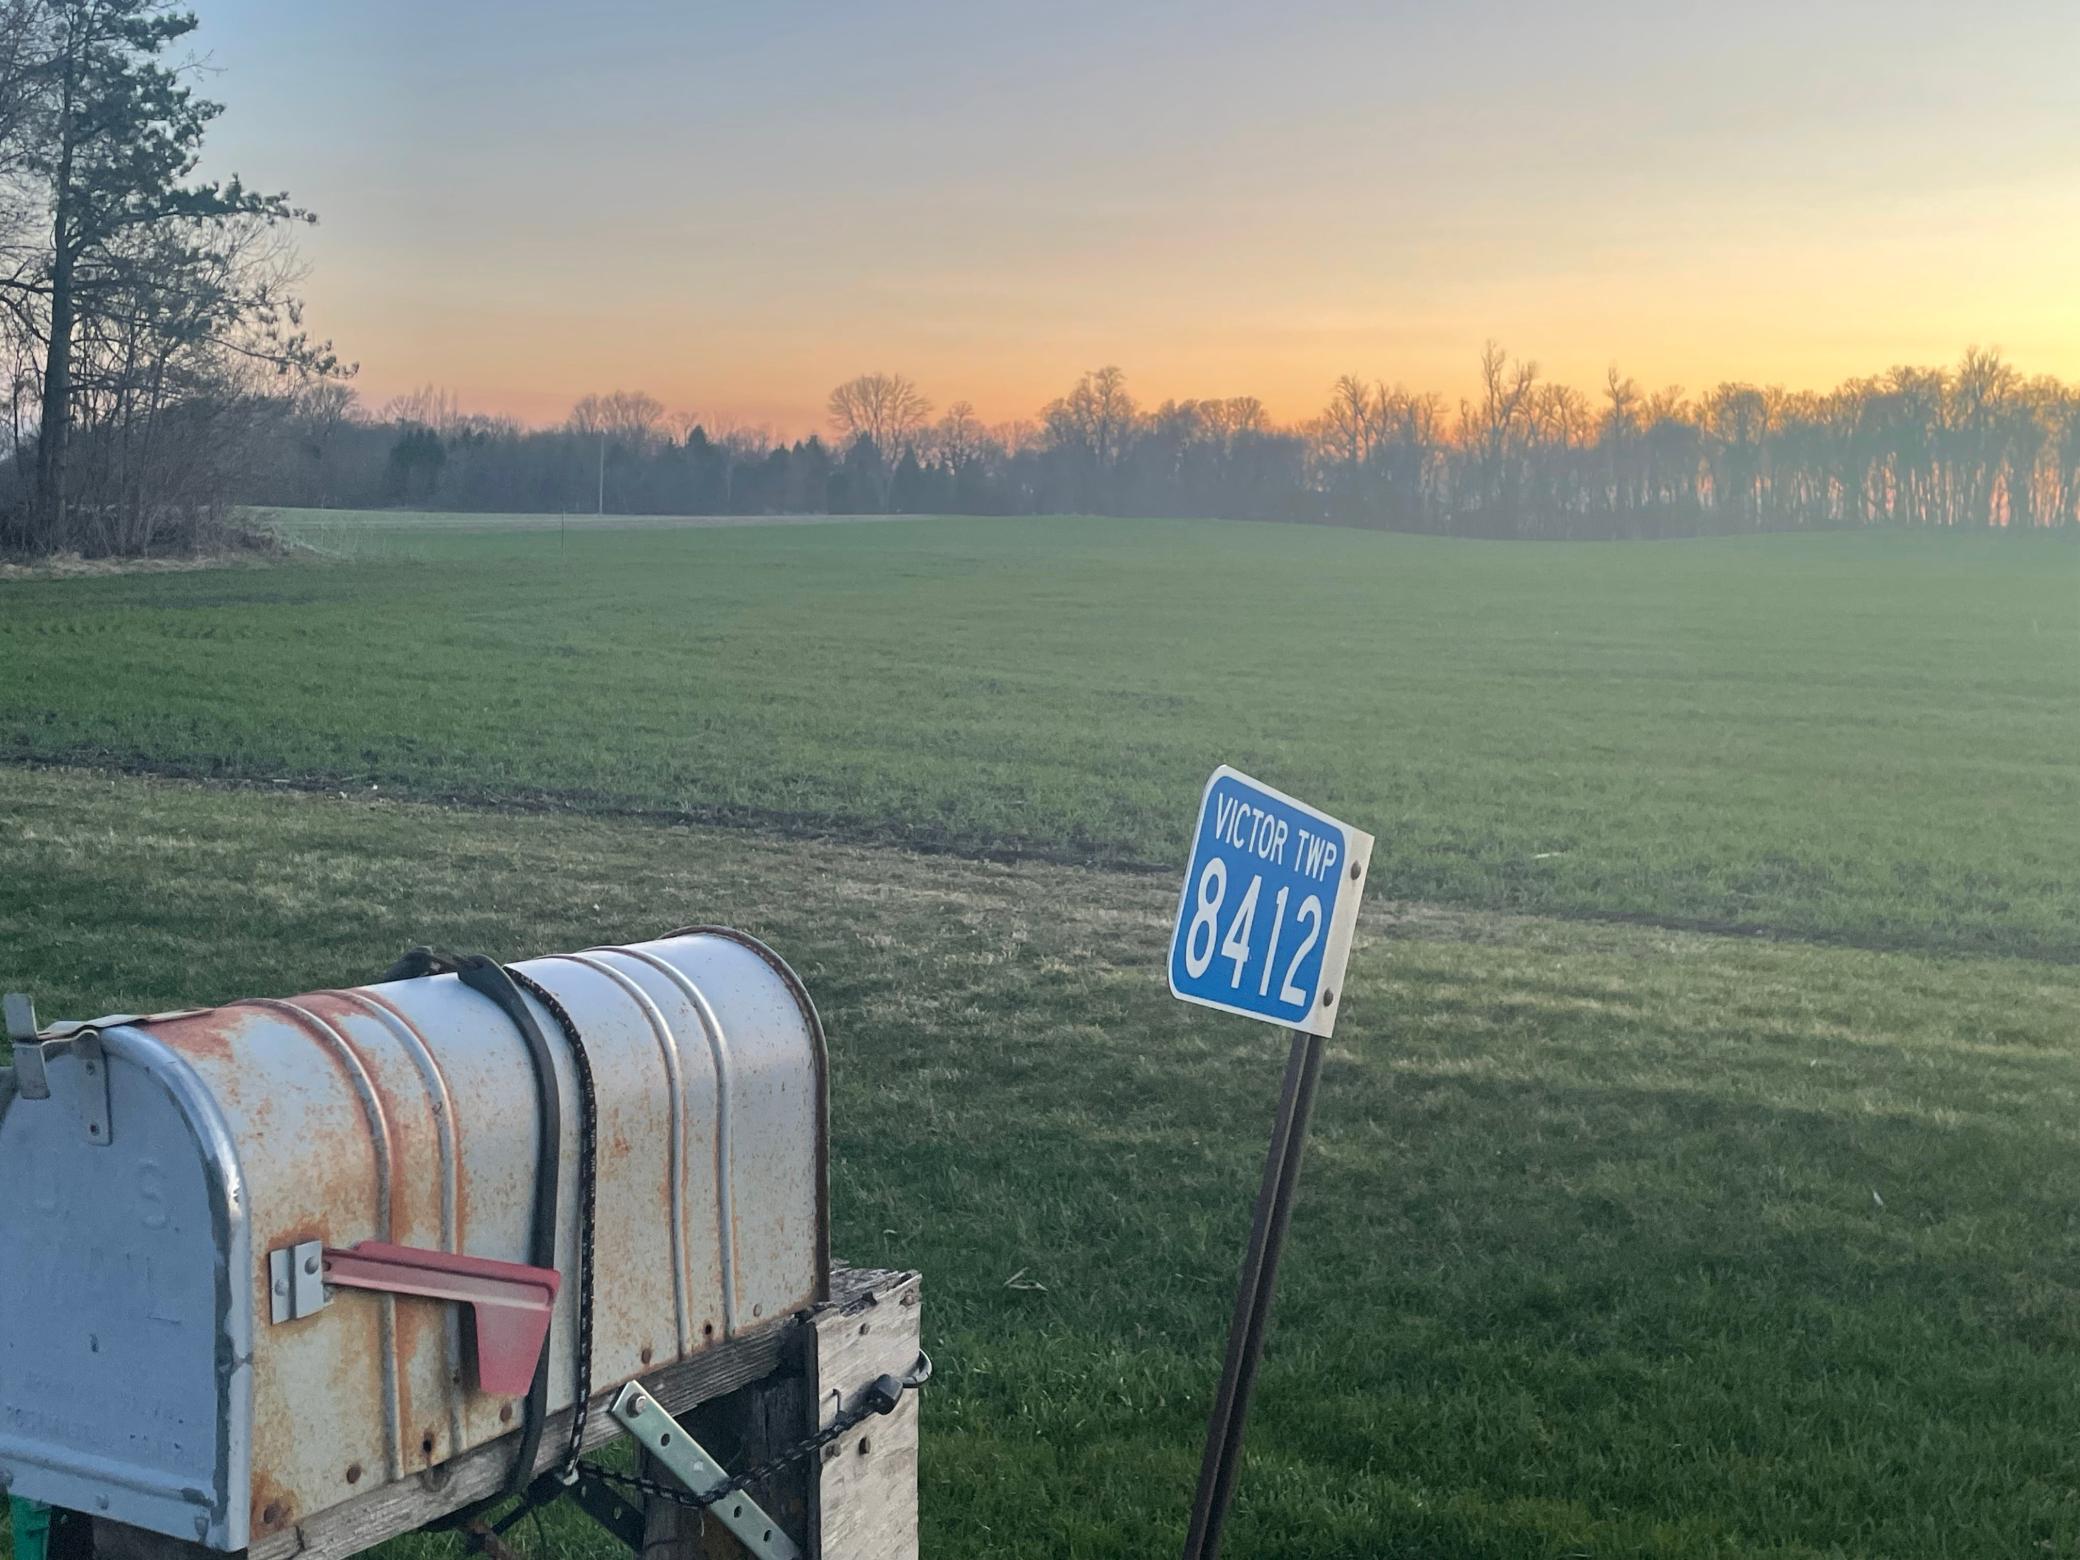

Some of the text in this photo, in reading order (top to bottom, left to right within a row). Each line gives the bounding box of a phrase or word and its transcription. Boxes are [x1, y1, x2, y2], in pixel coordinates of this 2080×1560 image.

[1215, 792, 1337, 882] VICTOR TWP
[1185, 857, 1322, 1007] 8412
